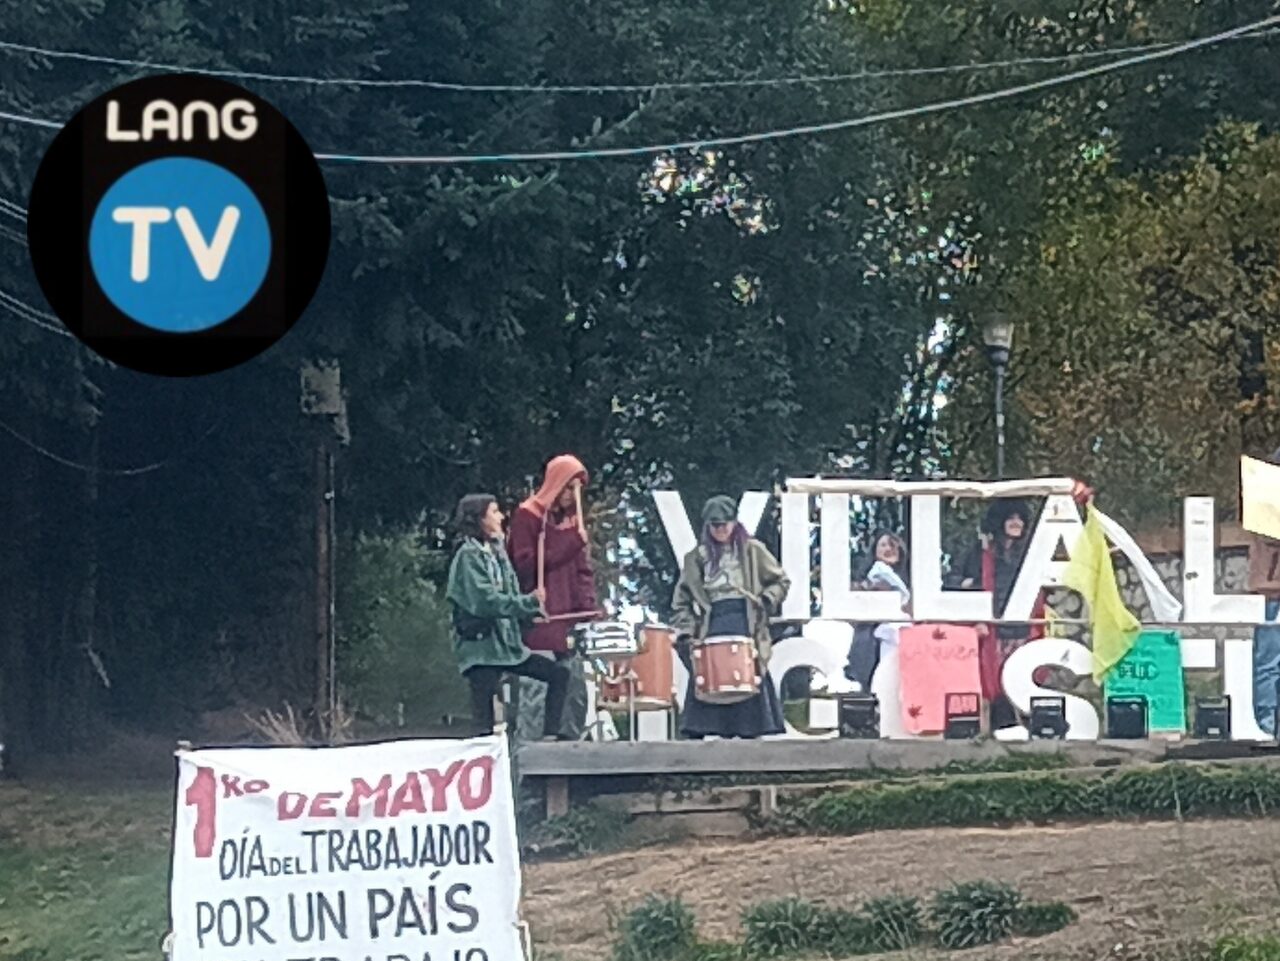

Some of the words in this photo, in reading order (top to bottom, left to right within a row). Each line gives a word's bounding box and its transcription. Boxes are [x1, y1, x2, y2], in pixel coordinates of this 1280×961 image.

[652, 489, 1104, 621] VILLA
[277, 790, 343, 821] DE
[344, 754, 494, 818] MAYO
[269, 855, 307, 877] DEL
[301, 820, 494, 873] TRABAJADOR
[196, 895, 277, 949] POR
[287, 889, 349, 943] UN
[366, 870, 480, 940] PAÍS
